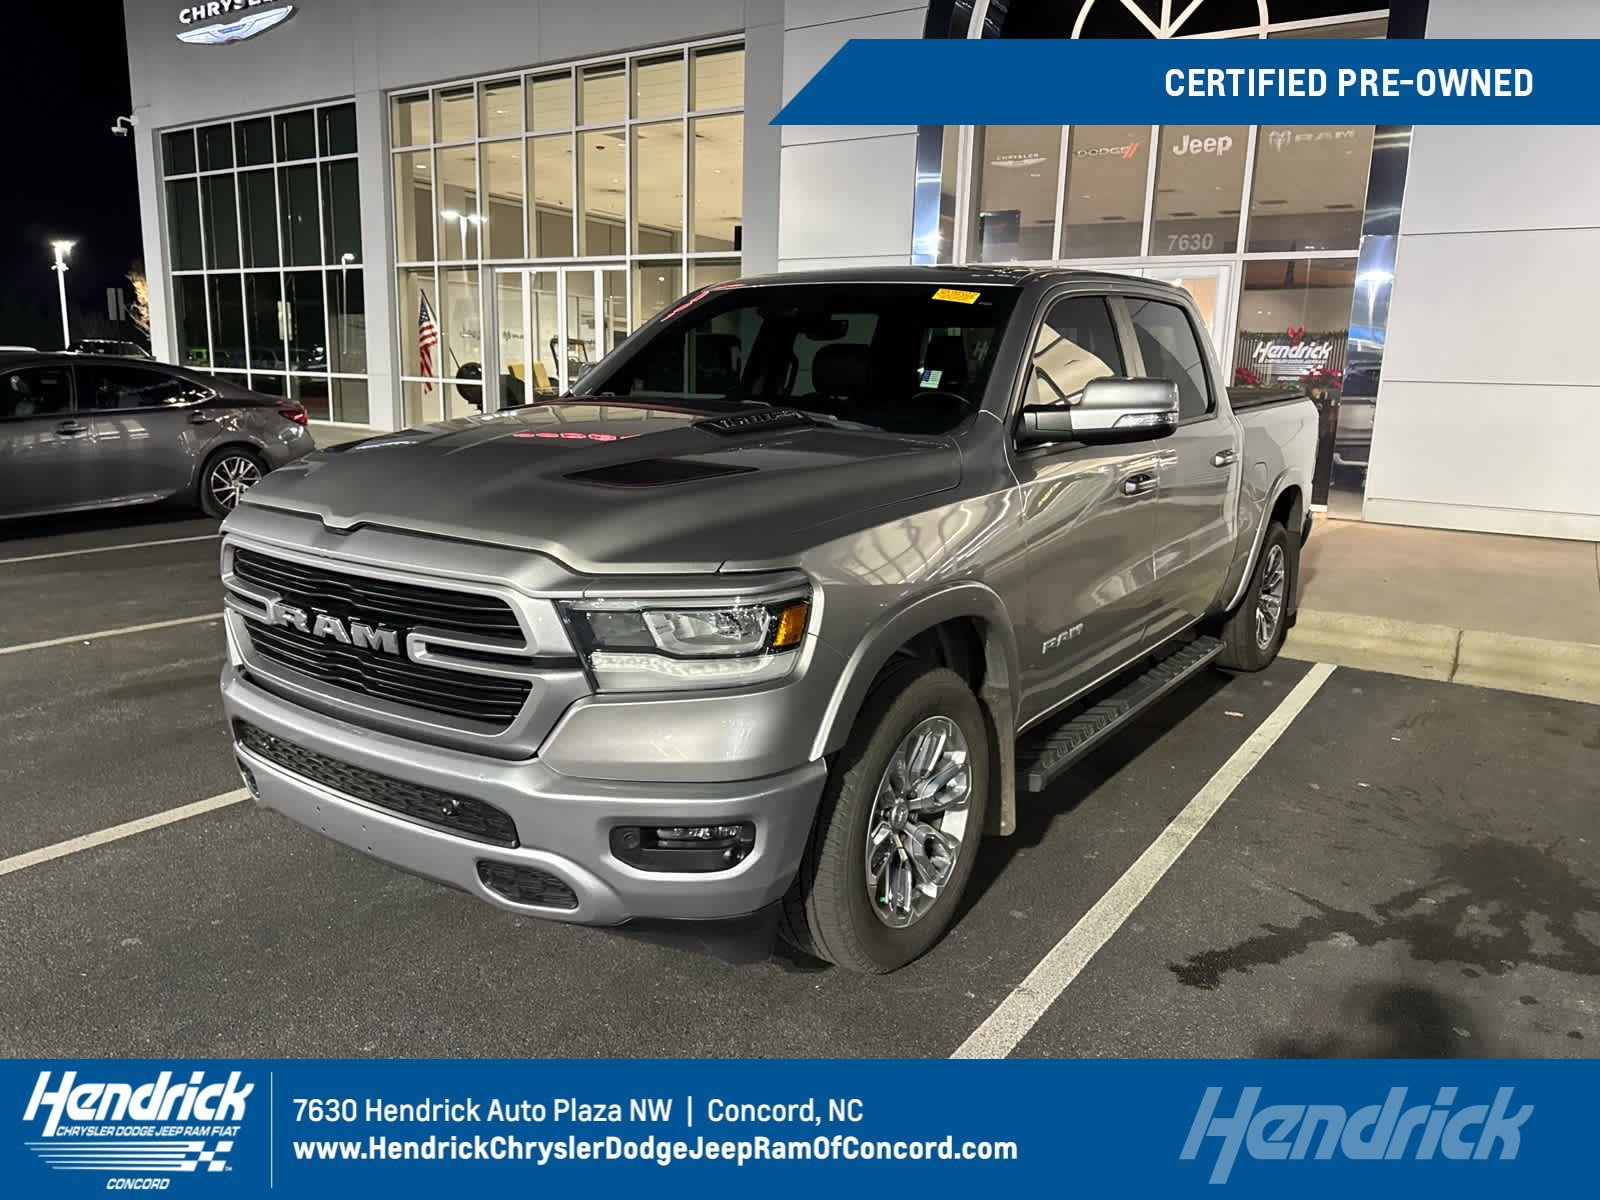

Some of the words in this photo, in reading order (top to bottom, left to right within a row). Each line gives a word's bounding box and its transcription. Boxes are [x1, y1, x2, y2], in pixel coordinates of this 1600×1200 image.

[1172, 133, 1233, 157] Jeep
[1167, 233, 1214, 252] 7630
[1253, 341, 1333, 364] Hendrick
[273, 602, 400, 655] RAM
[1041, 622, 1084, 655] RAM
